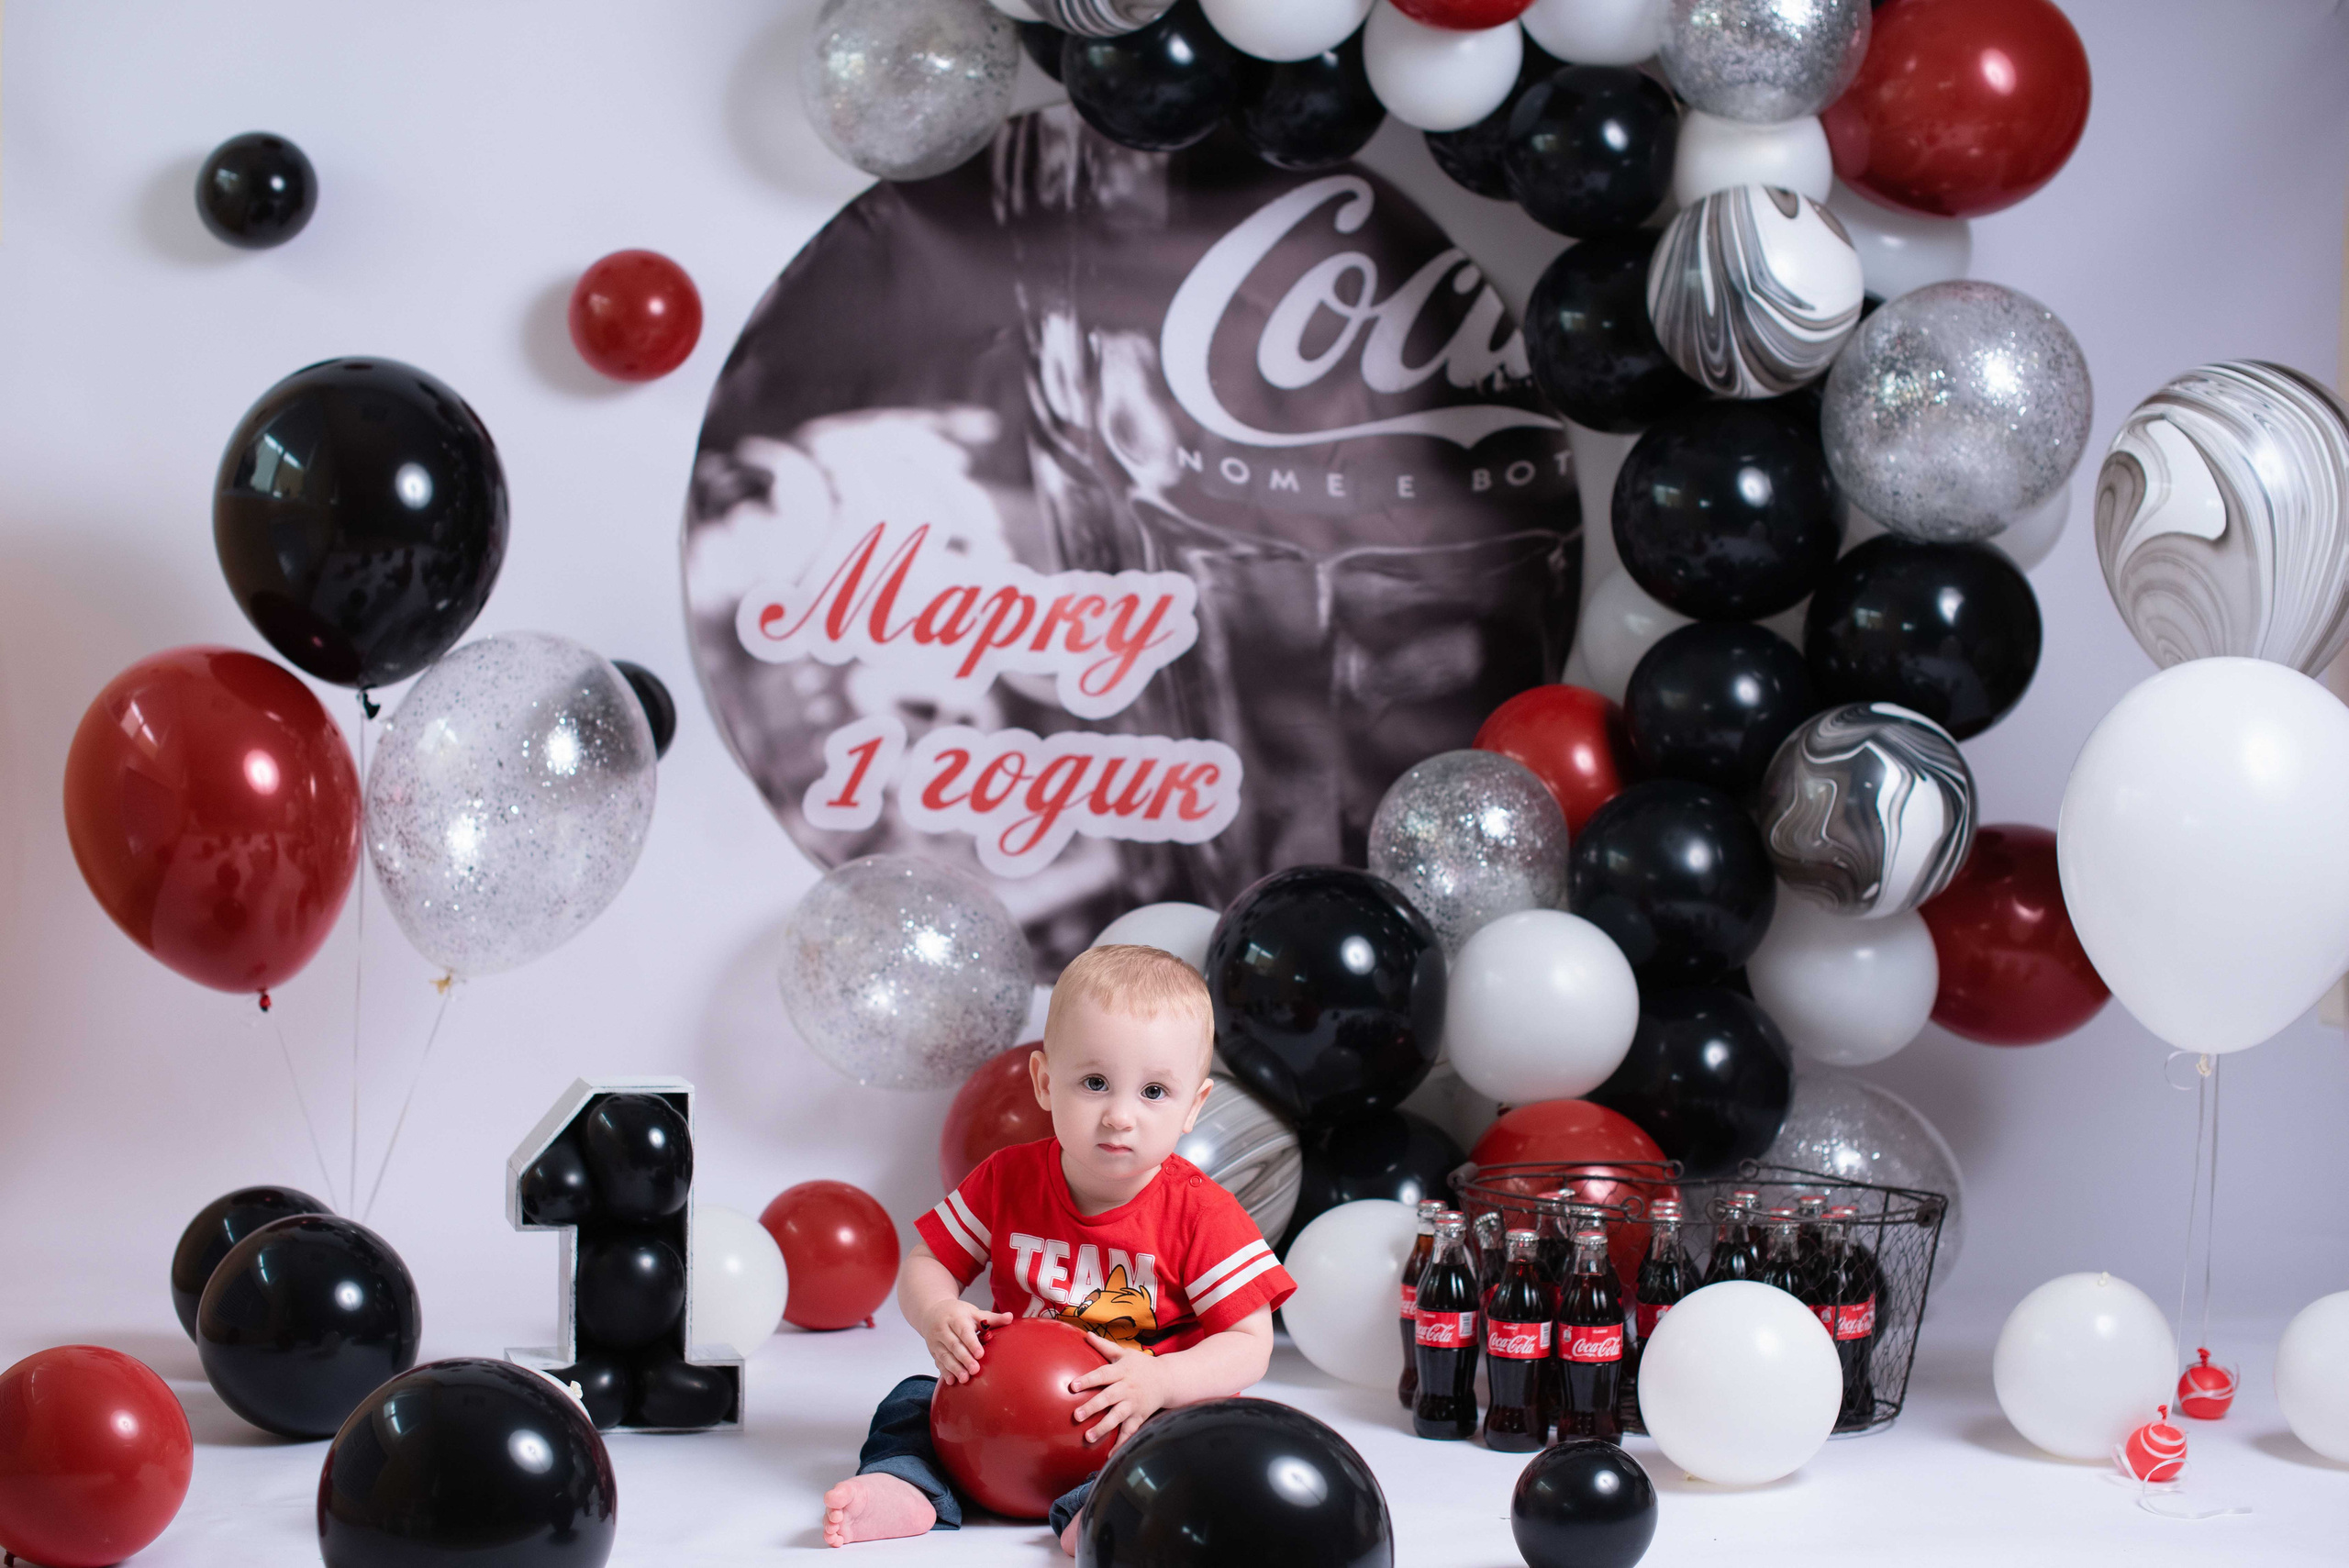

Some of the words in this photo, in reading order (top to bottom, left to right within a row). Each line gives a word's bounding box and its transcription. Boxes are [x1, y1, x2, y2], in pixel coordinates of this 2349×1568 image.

[1176, 446, 1346, 497] NOME
[1397, 474, 1416, 498] E
[1472, 450, 1572, 493] BOT
[759, 521, 1175, 697] Марку
[826, 737, 884, 808] 1
[920, 748, 1220, 857] годик
[1009, 1232, 1158, 1313] TEAM
[1487, 1331, 1538, 1354] Coca-Cola
[1572, 1336, 1620, 1357] Coca-Cola
